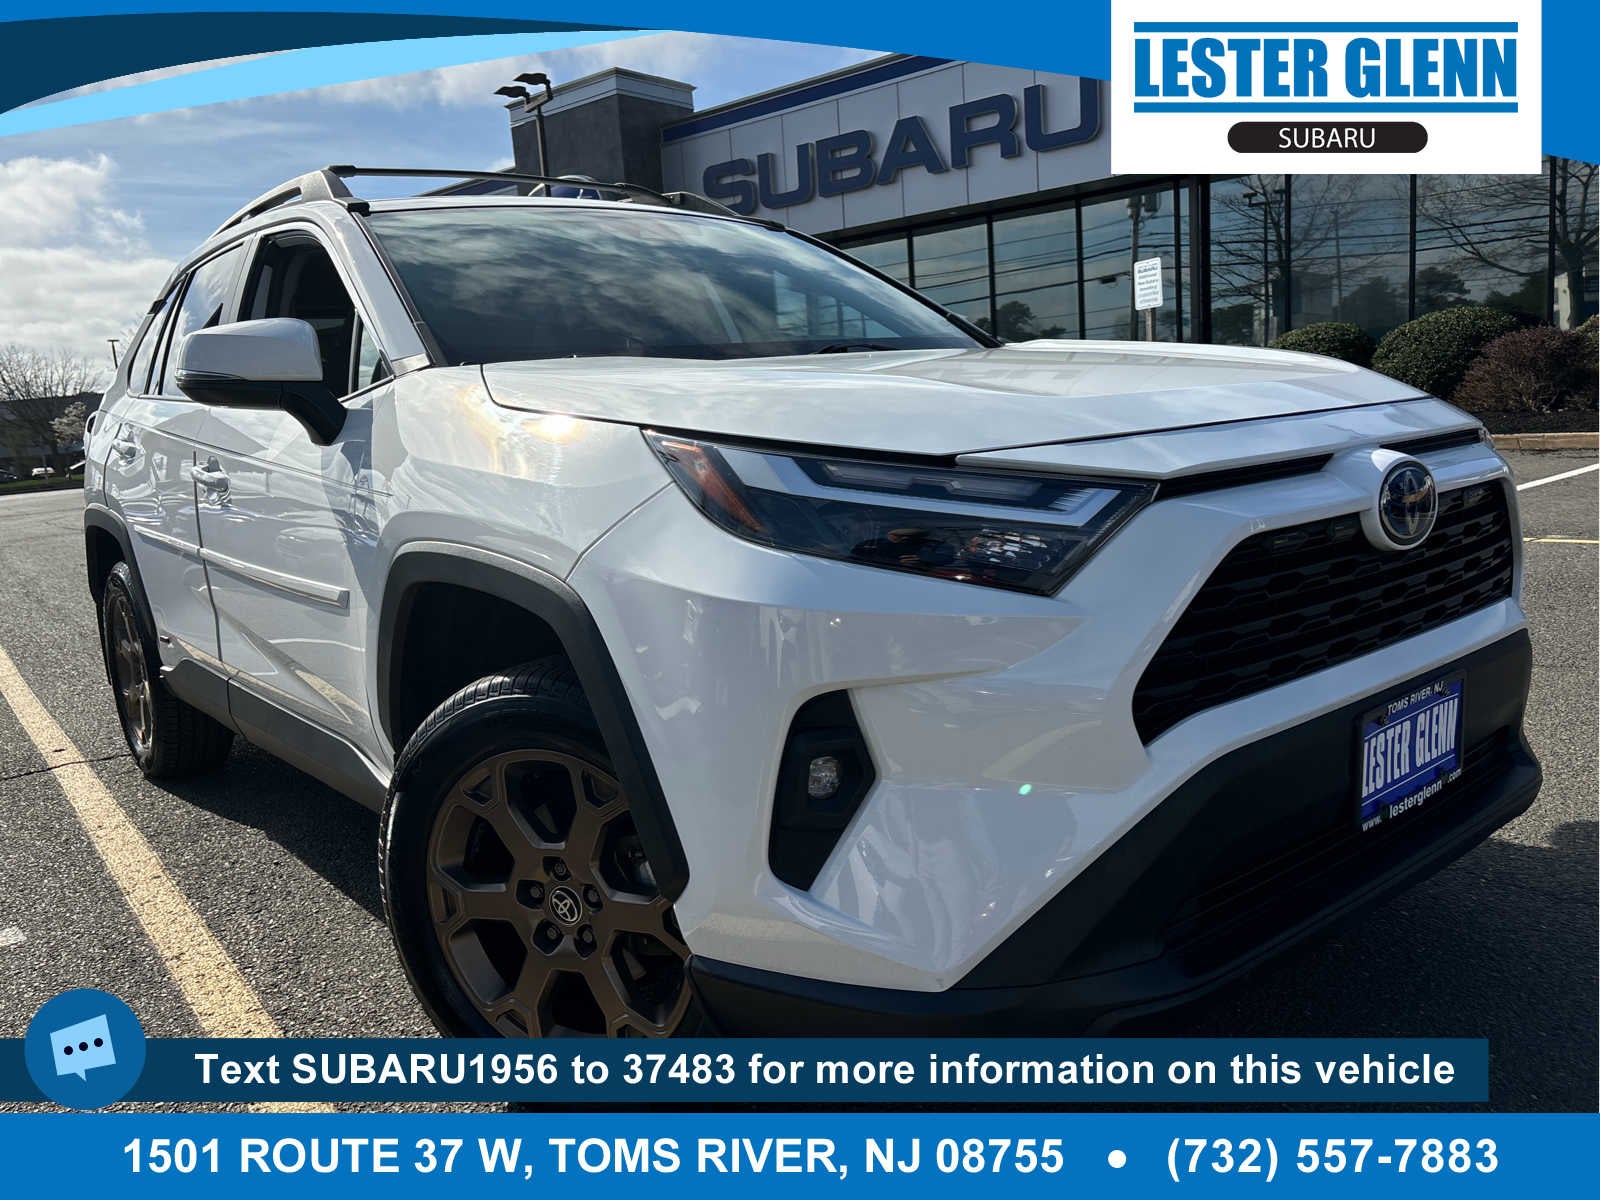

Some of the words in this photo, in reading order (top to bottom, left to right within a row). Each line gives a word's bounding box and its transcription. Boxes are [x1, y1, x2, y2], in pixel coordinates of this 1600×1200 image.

[702, 77, 1100, 216] SUBARU
[1387, 697, 1409, 716] TOMS
[1433, 680, 1444, 695] NJ
[1361, 720, 1411, 798] LESTER
[1415, 698, 1458, 768] GLENN
[1389, 780, 1442, 819] lesterglenn
